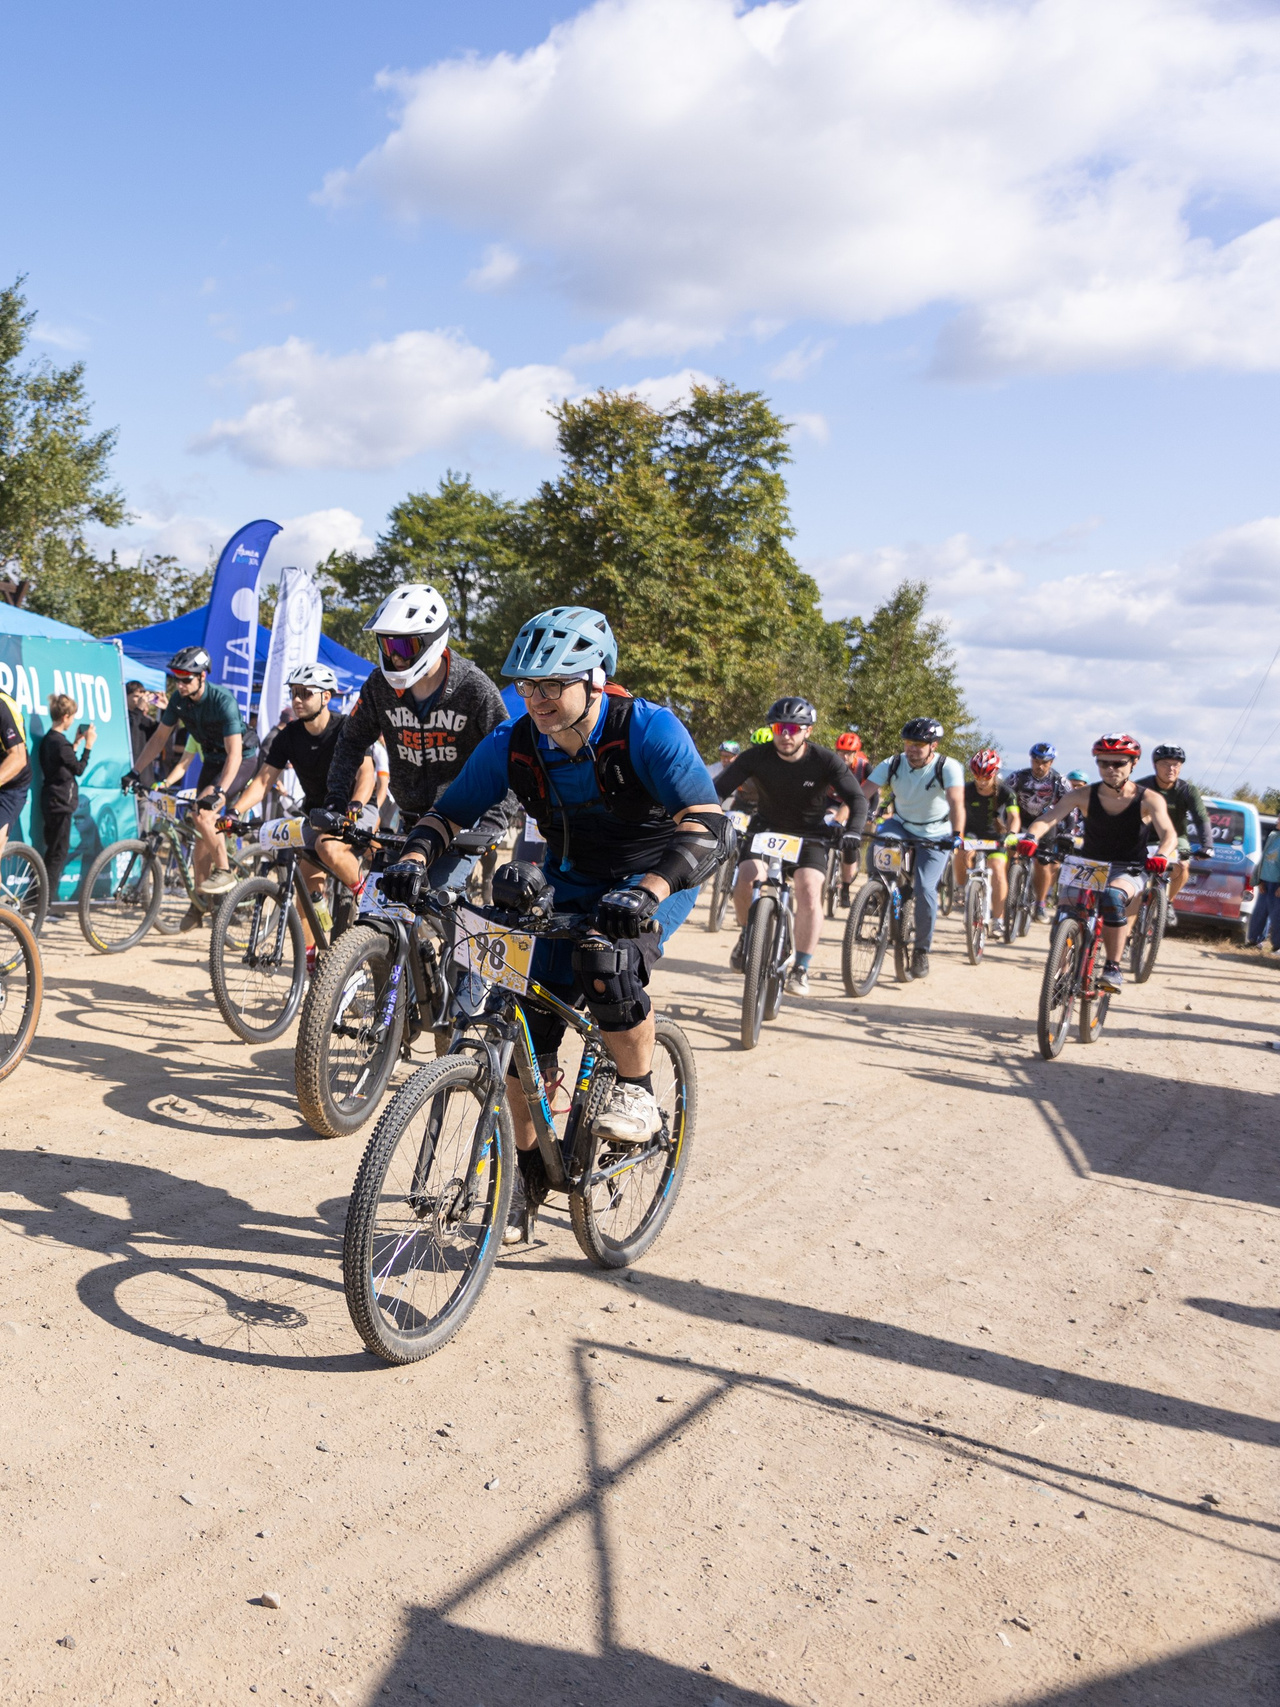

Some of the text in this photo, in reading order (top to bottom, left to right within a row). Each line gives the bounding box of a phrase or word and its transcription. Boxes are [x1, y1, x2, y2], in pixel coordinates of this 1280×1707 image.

[272, 823, 289, 841] 46
[767, 837, 787, 850] 87
[1074, 864, 1095, 881] 27
[476, 931, 506, 971] 98
